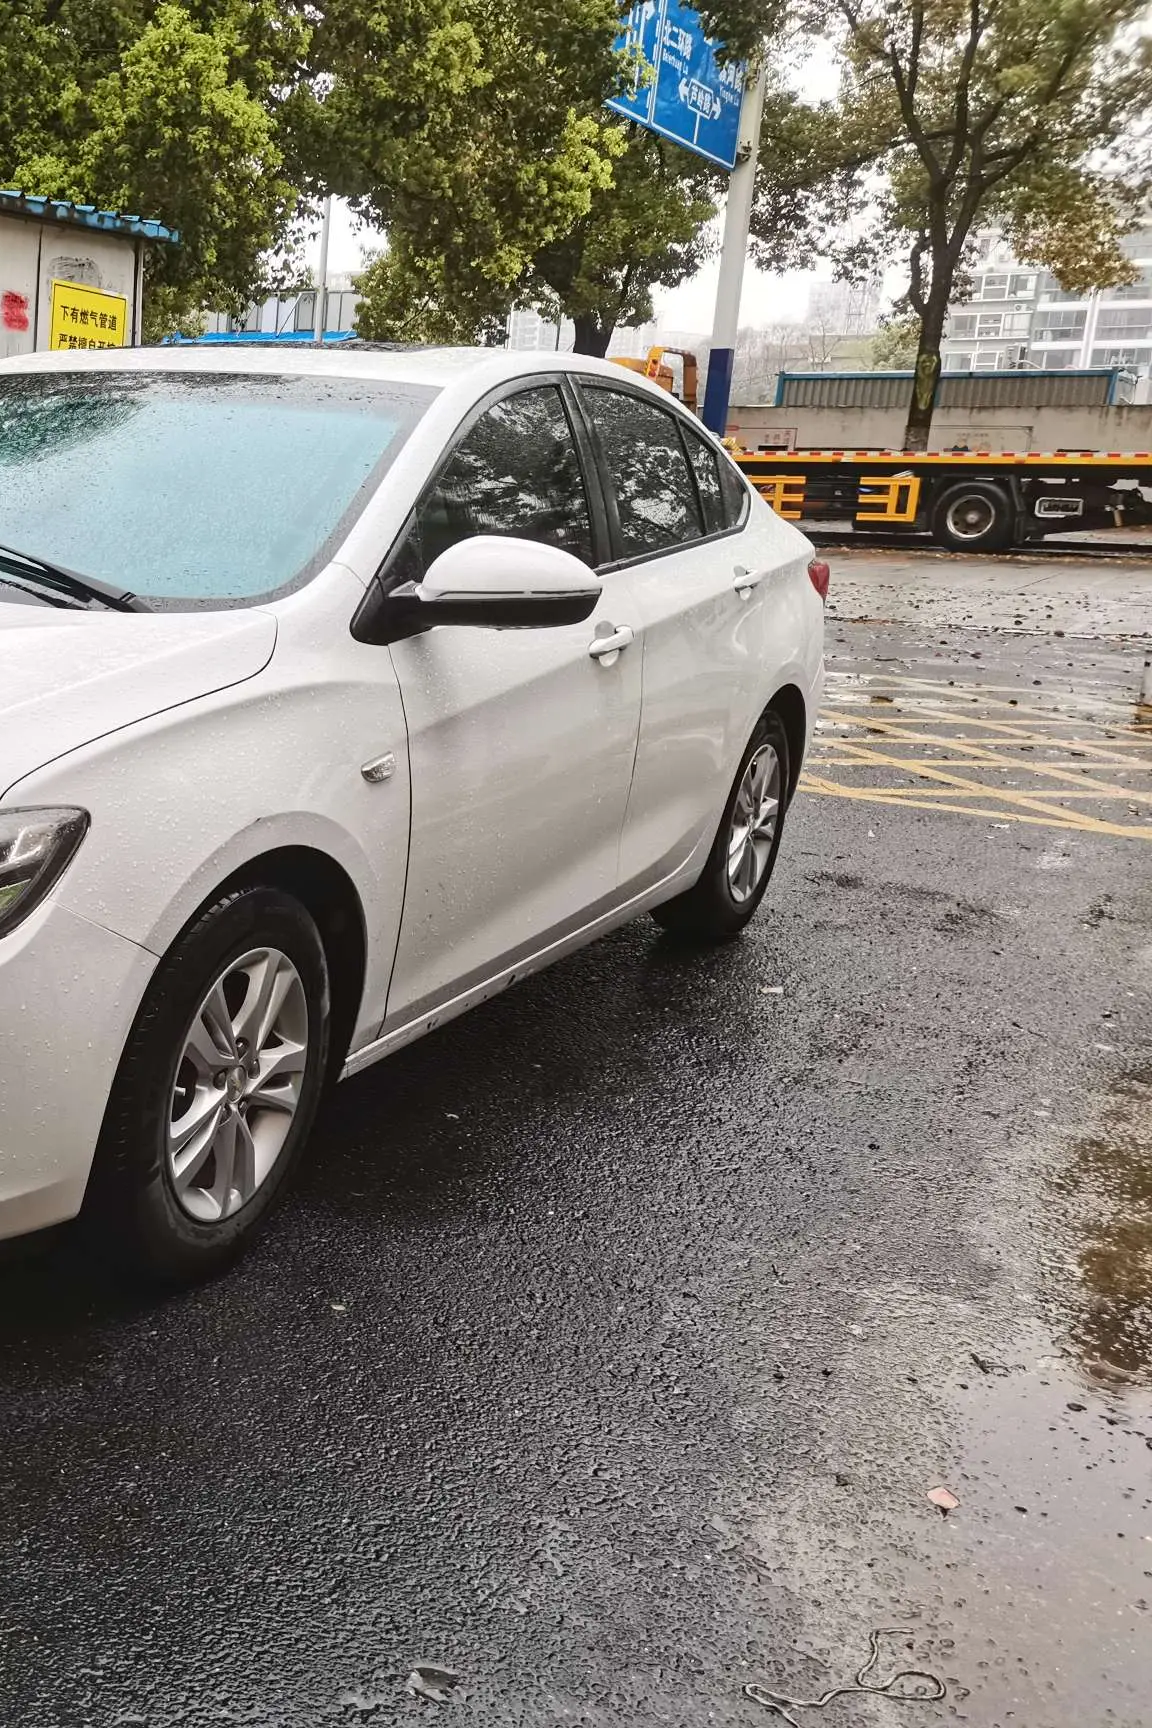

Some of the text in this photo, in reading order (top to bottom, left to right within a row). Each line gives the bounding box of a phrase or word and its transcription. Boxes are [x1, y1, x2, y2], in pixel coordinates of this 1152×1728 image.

[60, 304, 117, 331] 下有燃气管道
[58, 333, 116, 349] 严禁擅自开
